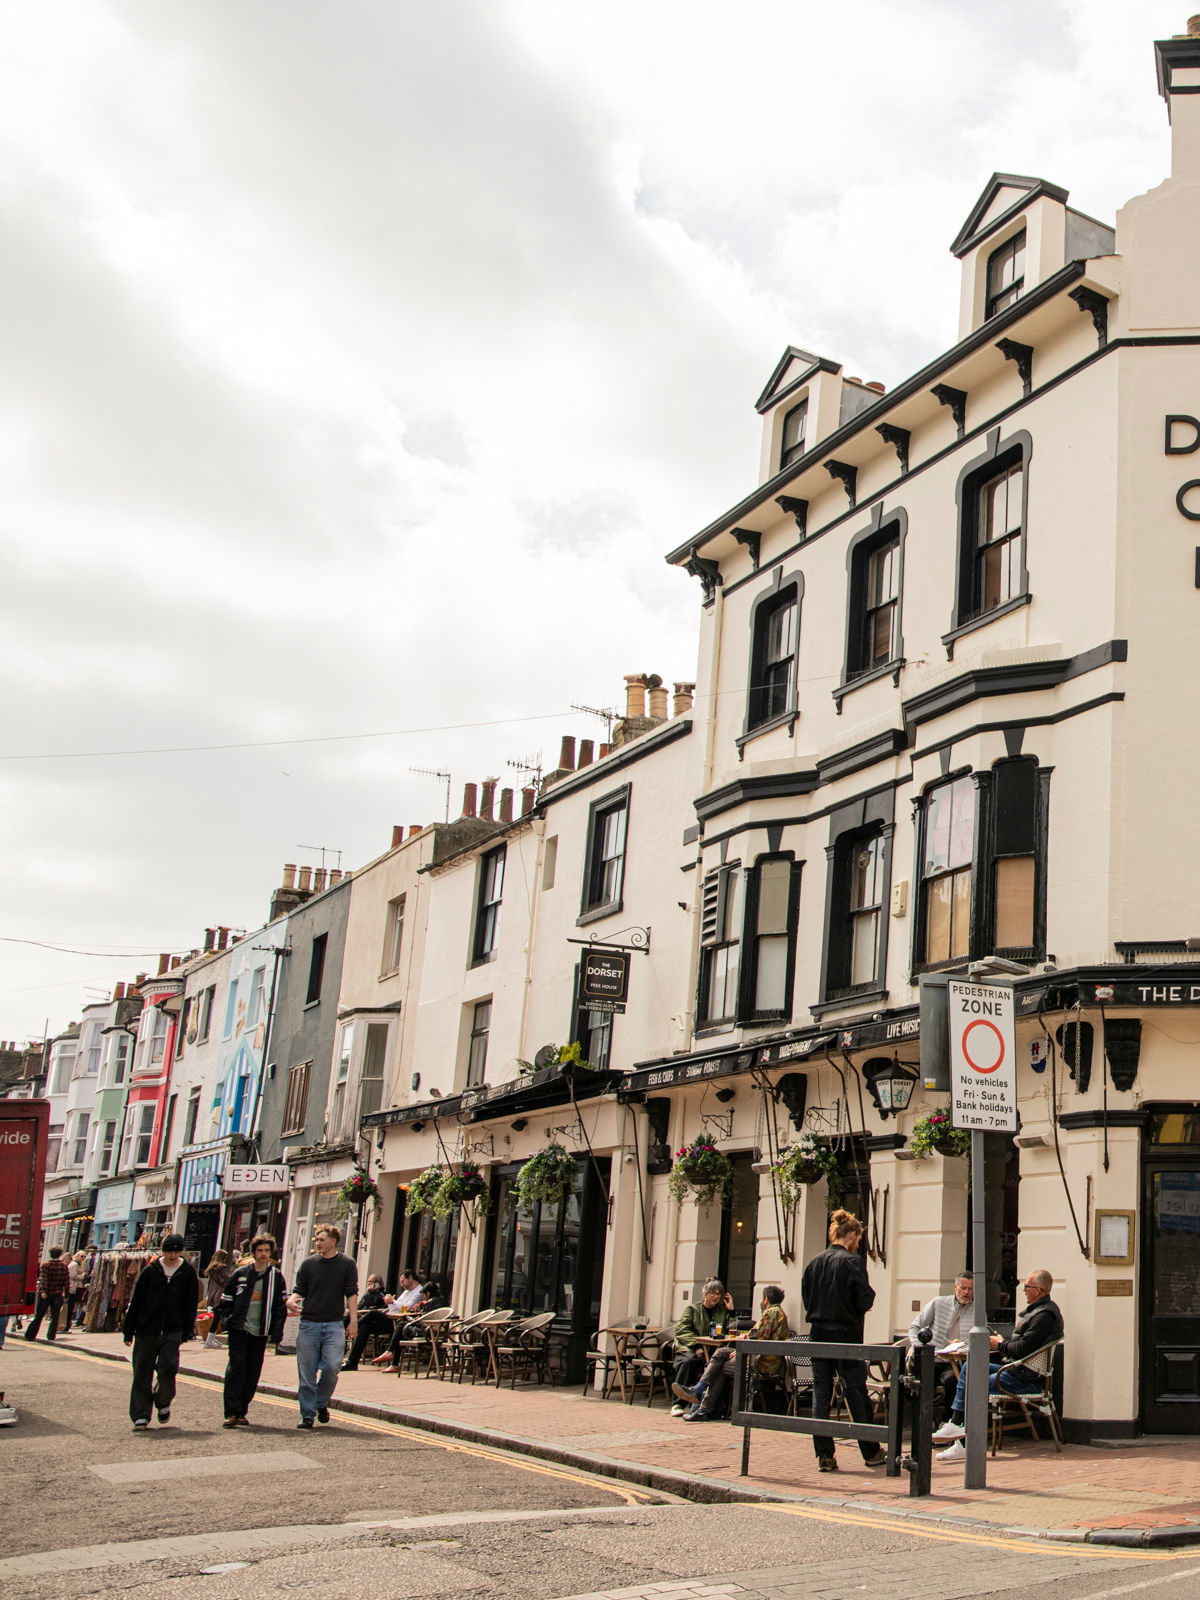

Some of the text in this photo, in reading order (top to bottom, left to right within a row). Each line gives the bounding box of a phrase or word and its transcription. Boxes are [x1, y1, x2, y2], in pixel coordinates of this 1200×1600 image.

[587, 967, 623, 978] DORSET
[952, 985, 1011, 1000] PEDESTRIAN
[1138, 987, 1182, 1001] THE
[961, 999, 1003, 1016] ZONE
[886, 1018, 920, 1038] LIVE MUSIC
[648, 1073, 658, 1085] FISH
[960, 1075, 1008, 1088] No vehicles
[963, 1089, 975, 1099] Fri
[981, 1091, 998, 1101] Sun
[1000, 1093, 1006, 1102] &
[956, 1101, 1013, 1114] Bank holidays
[231, 1169, 285, 1183] EDEN
